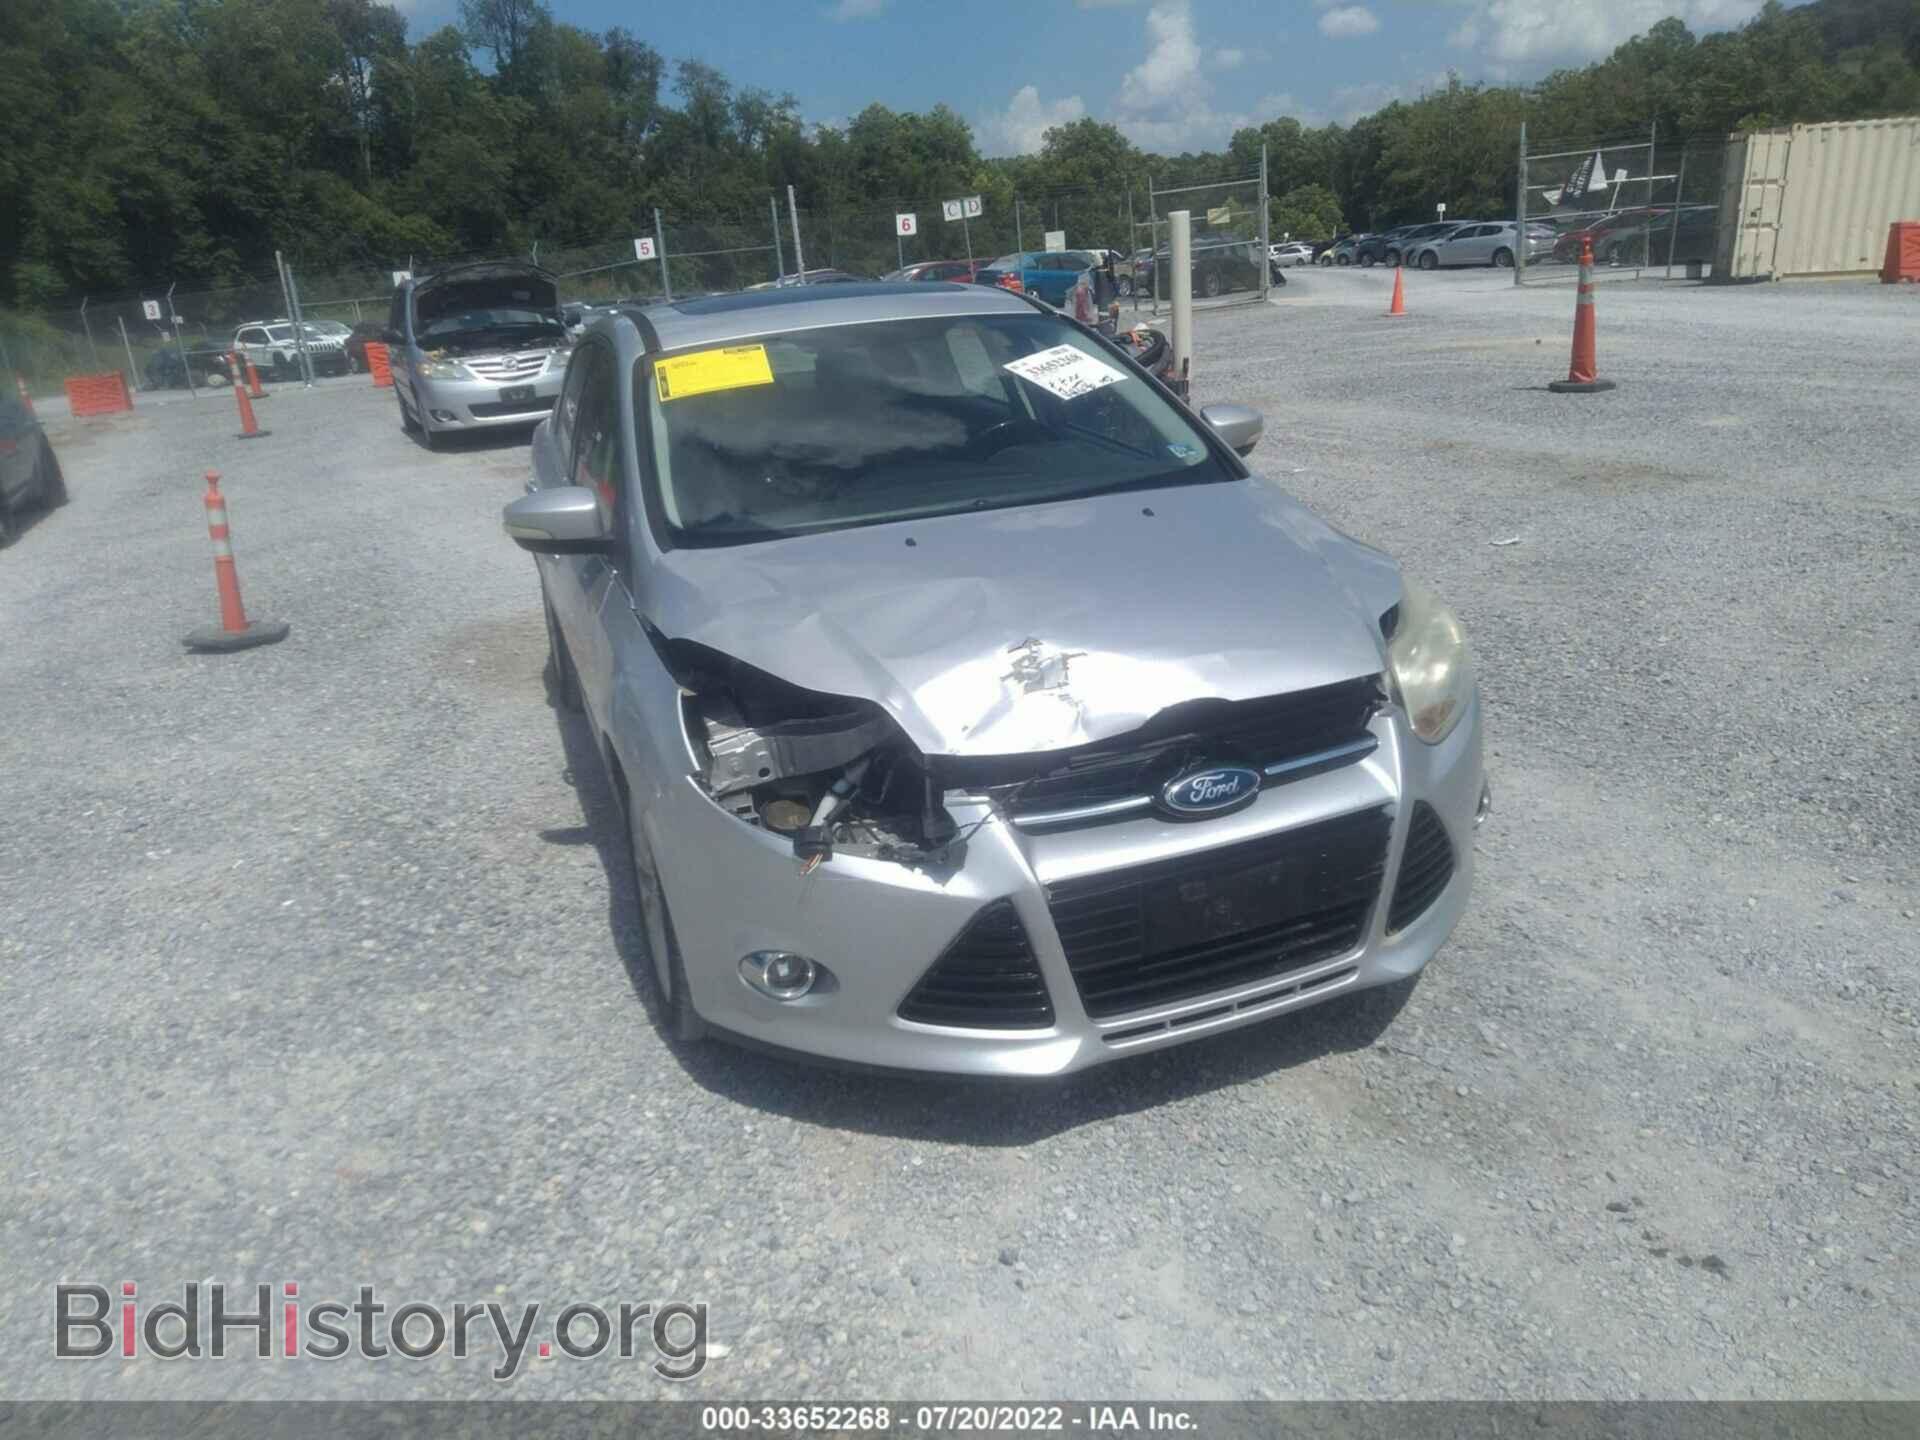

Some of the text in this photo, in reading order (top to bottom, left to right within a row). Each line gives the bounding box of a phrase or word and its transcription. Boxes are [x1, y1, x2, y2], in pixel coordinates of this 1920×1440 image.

[947, 201, 958, 217] C
[968, 200, 979, 213] D
[902, 218, 911, 232] 6
[640, 242, 650, 255] 5
[148, 304, 157, 317] 3
[1190, 773, 1239, 802] Ford
